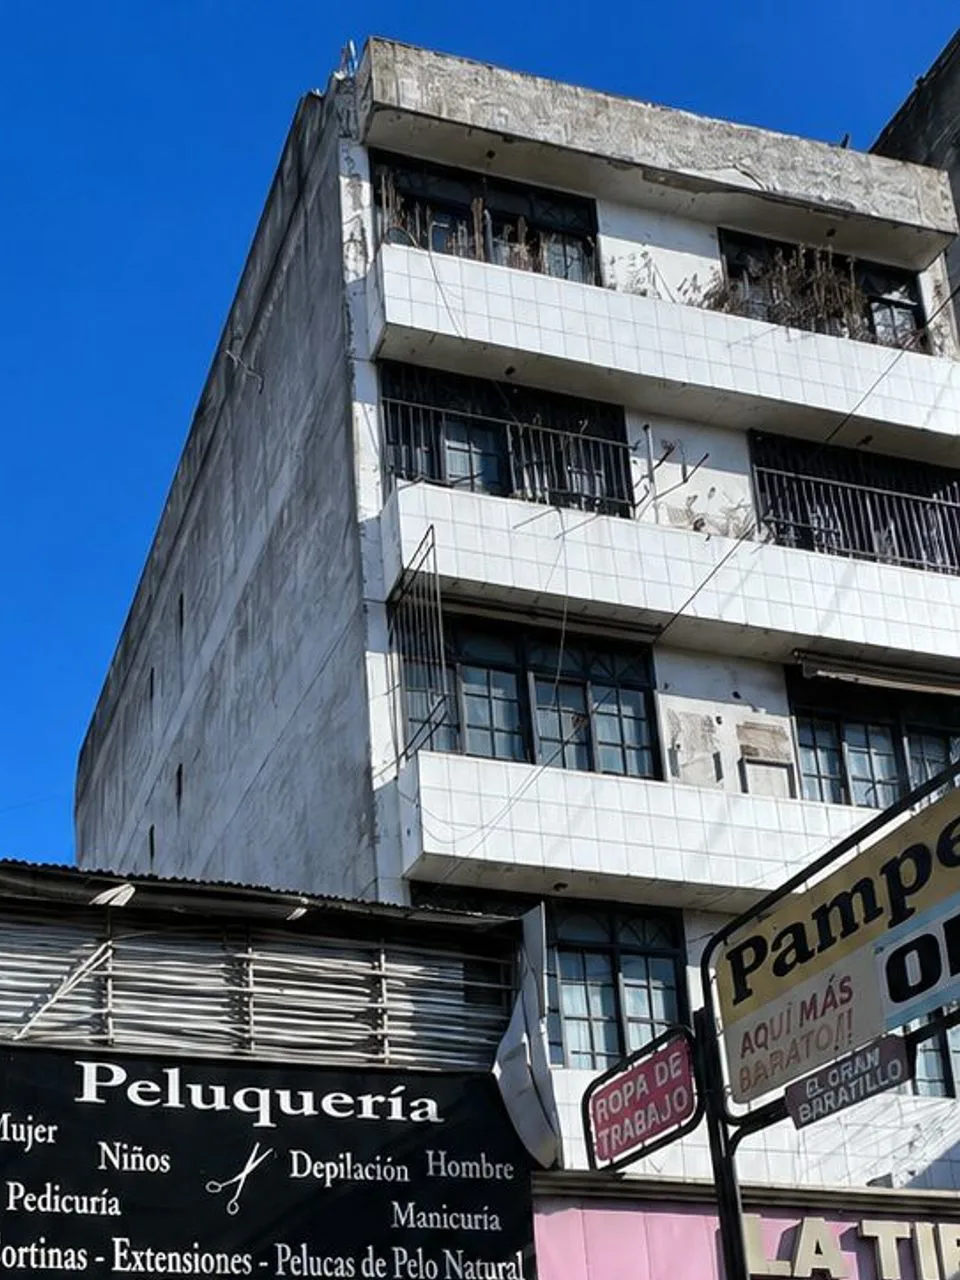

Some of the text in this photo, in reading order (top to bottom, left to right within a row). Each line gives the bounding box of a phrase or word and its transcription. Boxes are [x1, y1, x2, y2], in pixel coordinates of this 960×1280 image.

[799, 974, 854, 1028] MÁS
[74, 1060, 445, 1128] Peluquería
[595, 1051, 682, 1126] ROPA DE
[798, 1059, 902, 1123] BARATILLO
[598, 1085, 689, 1157] TRABAJO
[97, 1141, 171, 1173] Niños
[290, 1149, 411, 1188] Depilación
[425, 1149, 514, 1180] Hombre
[6, 1180, 122, 1217] Pedicuría
[391, 1200, 502, 1231] Manicuría
[111, 1237, 252, 1275] Extensiones
[274, 1243, 355, 1278] Pelucas
[361, 1245, 387, 1279] de
[392, 1247, 438, 1280] Pelo
[741, 1213, 849, 1280] LA
